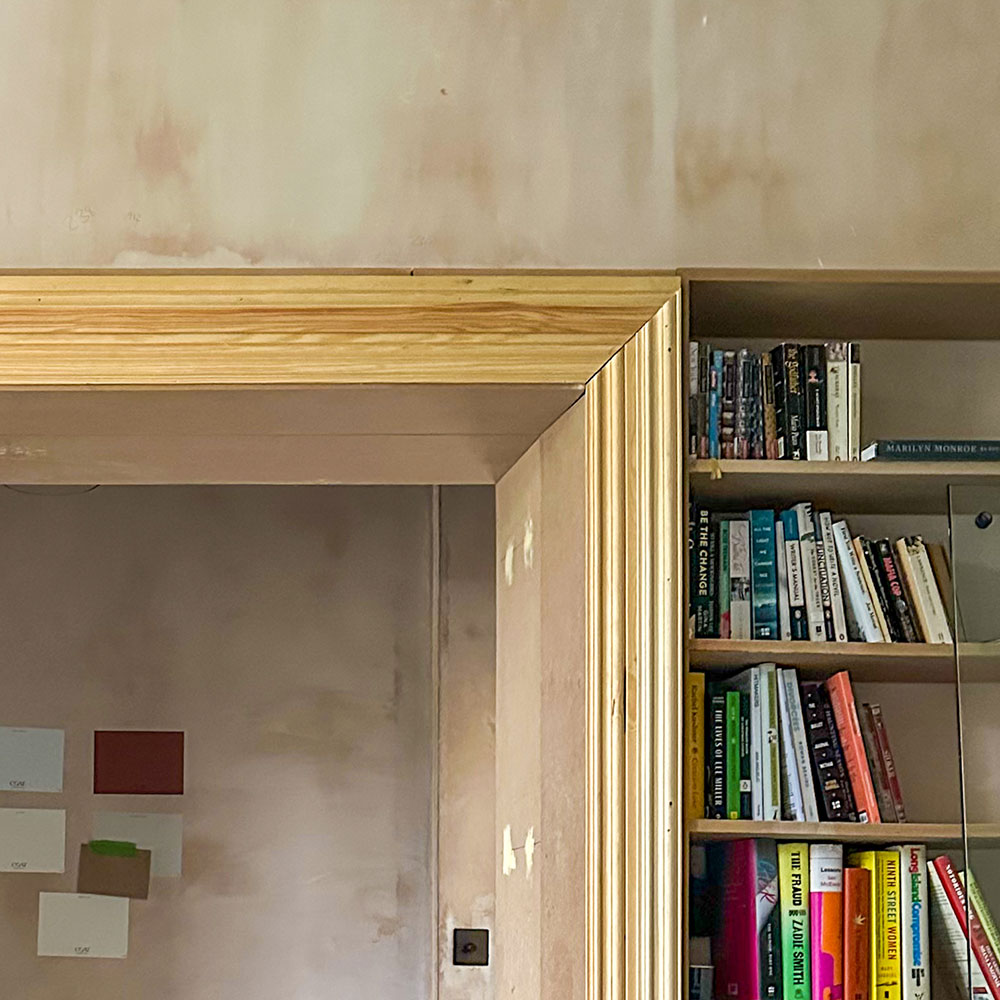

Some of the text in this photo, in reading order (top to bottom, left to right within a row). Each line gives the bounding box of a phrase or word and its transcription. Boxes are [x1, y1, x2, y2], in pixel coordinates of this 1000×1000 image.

[886, 444, 931, 453] MARILYN
[934, 444, 977, 453] MONROE
[699, 510, 709, 596] BE THE CHANGE
[790, 543, 800, 602] WRITER'S MANUAL
[816, 543, 830, 602] PUNCTUATION
[882, 556, 902, 597] MAFIA COP
[714, 709, 723, 723] THE
[714, 725, 723, 748] LIVES
[714, 749, 723, 758] OF
[714, 761, 723, 775] LEE
[714, 777, 723, 806] MILLER
[791, 851, 801, 870] THE
[792, 873, 802, 906] FRAUD
[887, 860, 897, 960] NINTH STREET WOMEN
[792, 920, 804, 950] ZADIE
[910, 902, 922, 966] Compromise
[792, 951, 804, 985] SMITH
